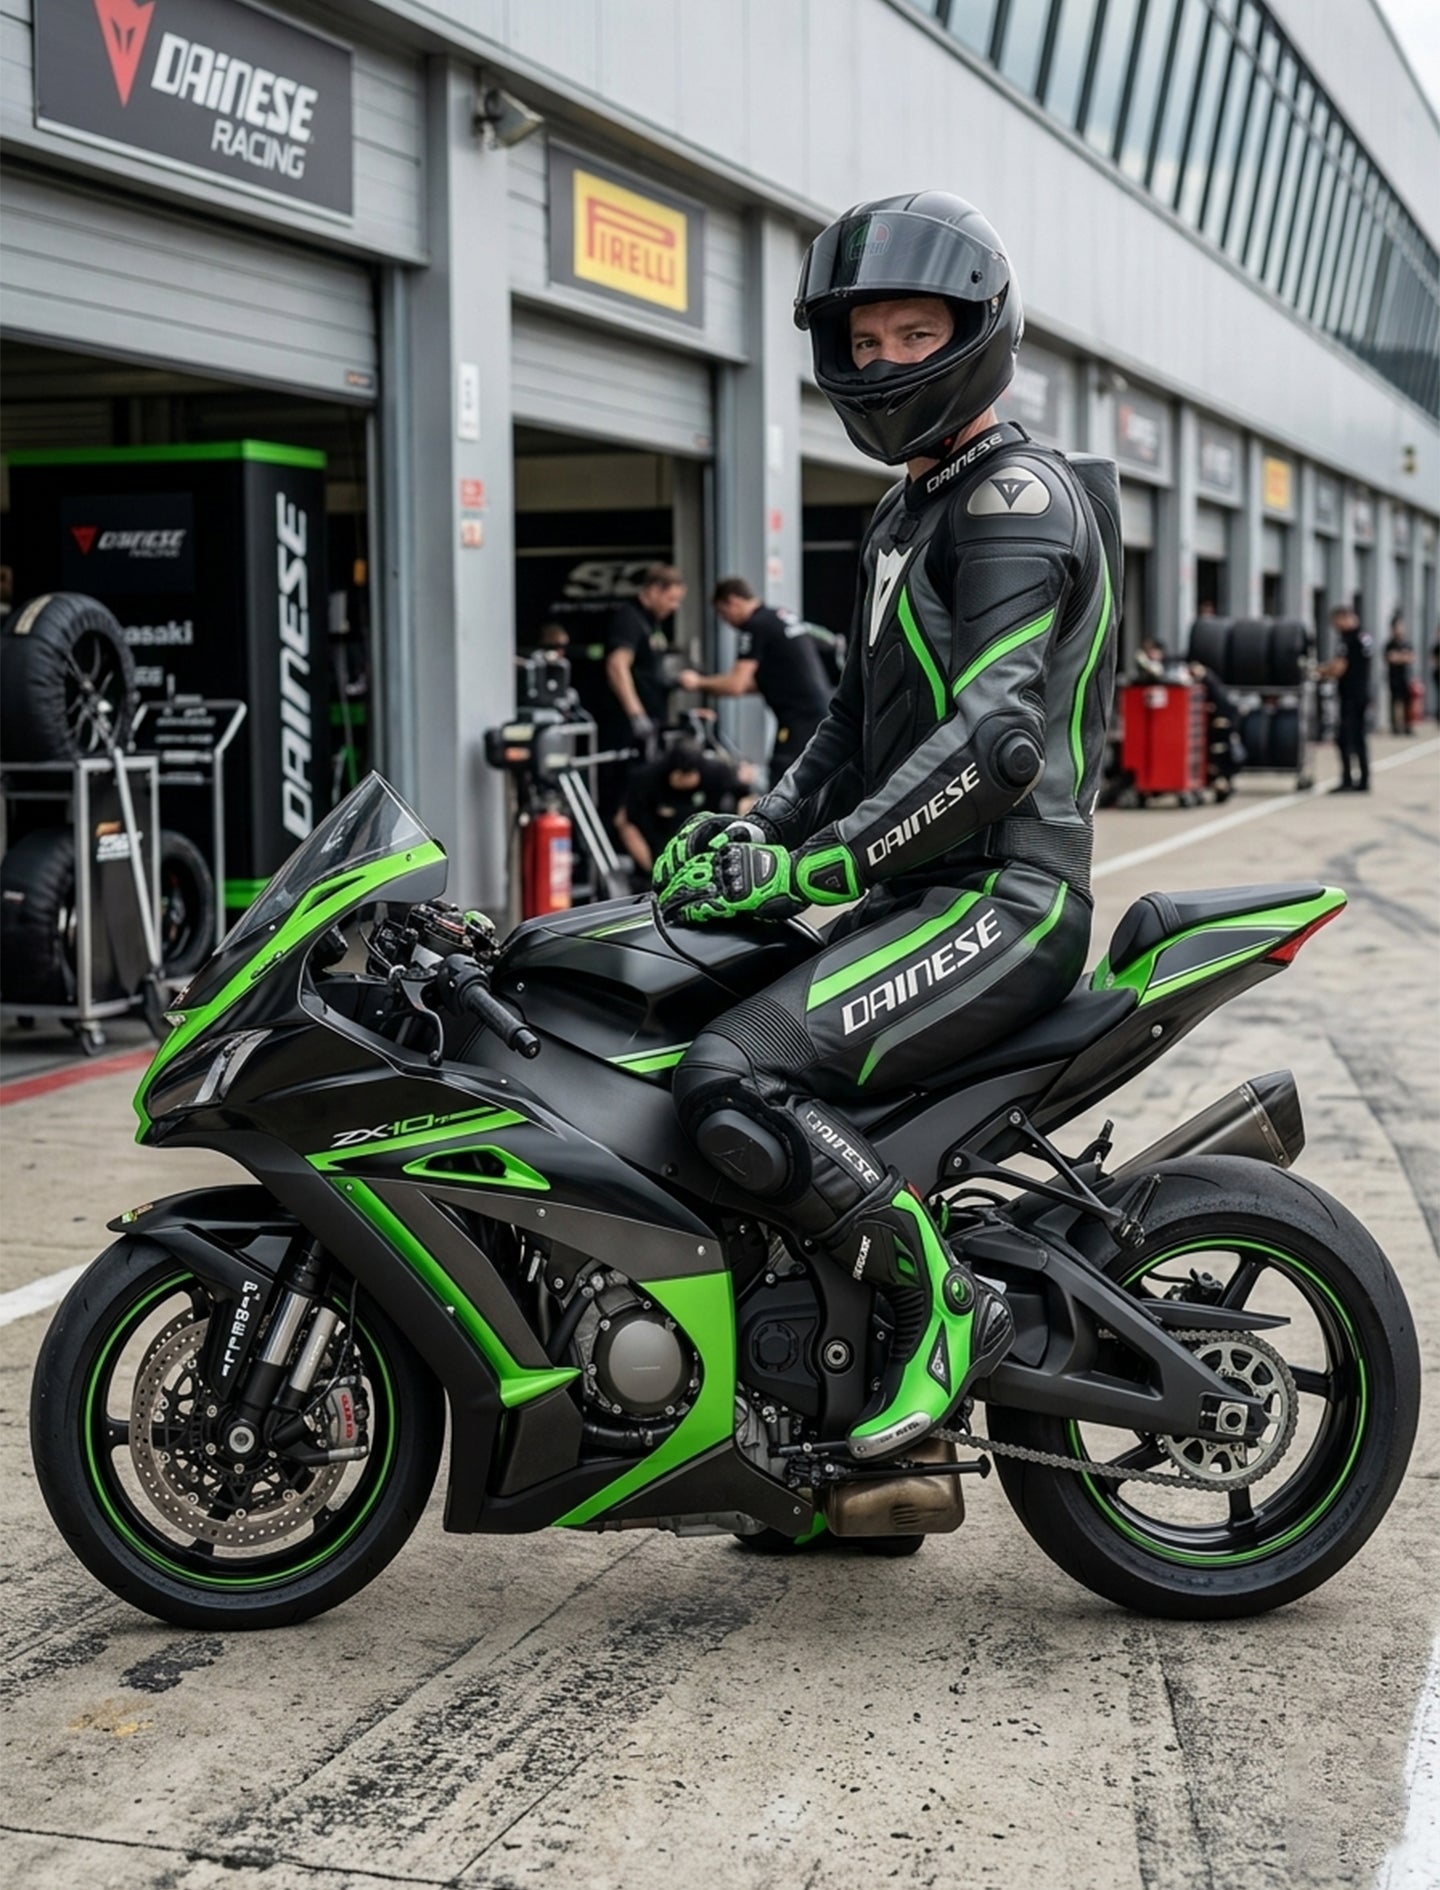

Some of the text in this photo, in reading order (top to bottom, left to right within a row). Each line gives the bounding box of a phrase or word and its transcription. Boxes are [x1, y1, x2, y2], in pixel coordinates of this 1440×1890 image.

[211, 118, 306, 180] RACING
[586, 197, 676, 288] PIRELLI
[926, 432, 1003, 493] DAINESE
[276, 492, 313, 841] DAINESE
[866, 762, 980, 867] DAINESE
[841, 908, 1002, 1036] DAINESE
